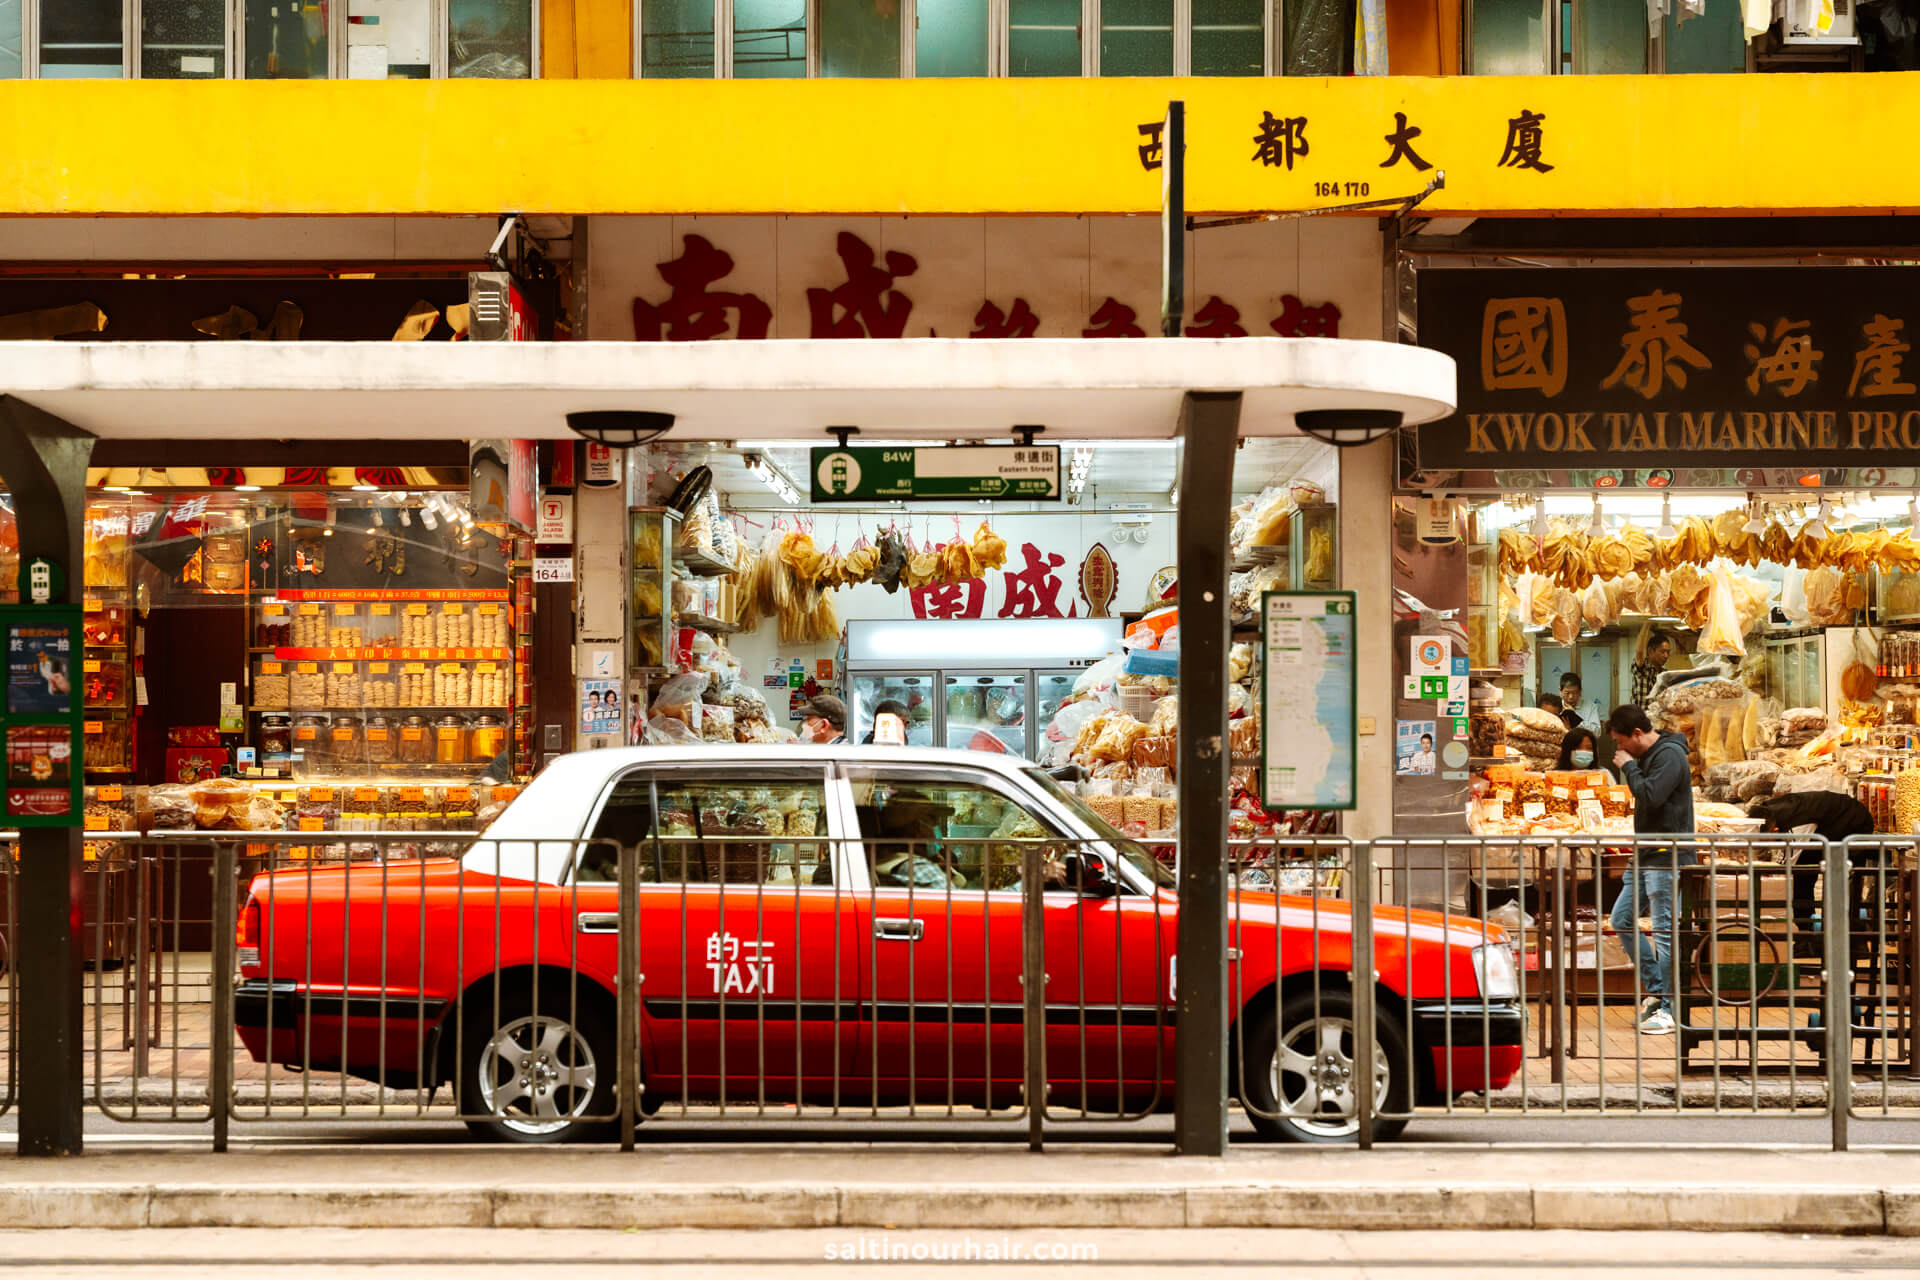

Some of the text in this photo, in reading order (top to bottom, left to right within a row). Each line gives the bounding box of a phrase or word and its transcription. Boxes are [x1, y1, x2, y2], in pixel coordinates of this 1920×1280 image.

[1313, 181, 1370, 197] 164 170
[1481, 288, 1918, 399] 國泰海產
[1466, 412, 1596, 453] KWOK
[1602, 411, 1672, 452] TAI
[1680, 411, 1838, 452] MARINE
[883, 451, 912, 463] 84W
[1030, 465, 1054, 473] Street
[535, 569, 559, 580] 164
[706, 931, 775, 962] 的士
[705, 963, 775, 994] TAXI
